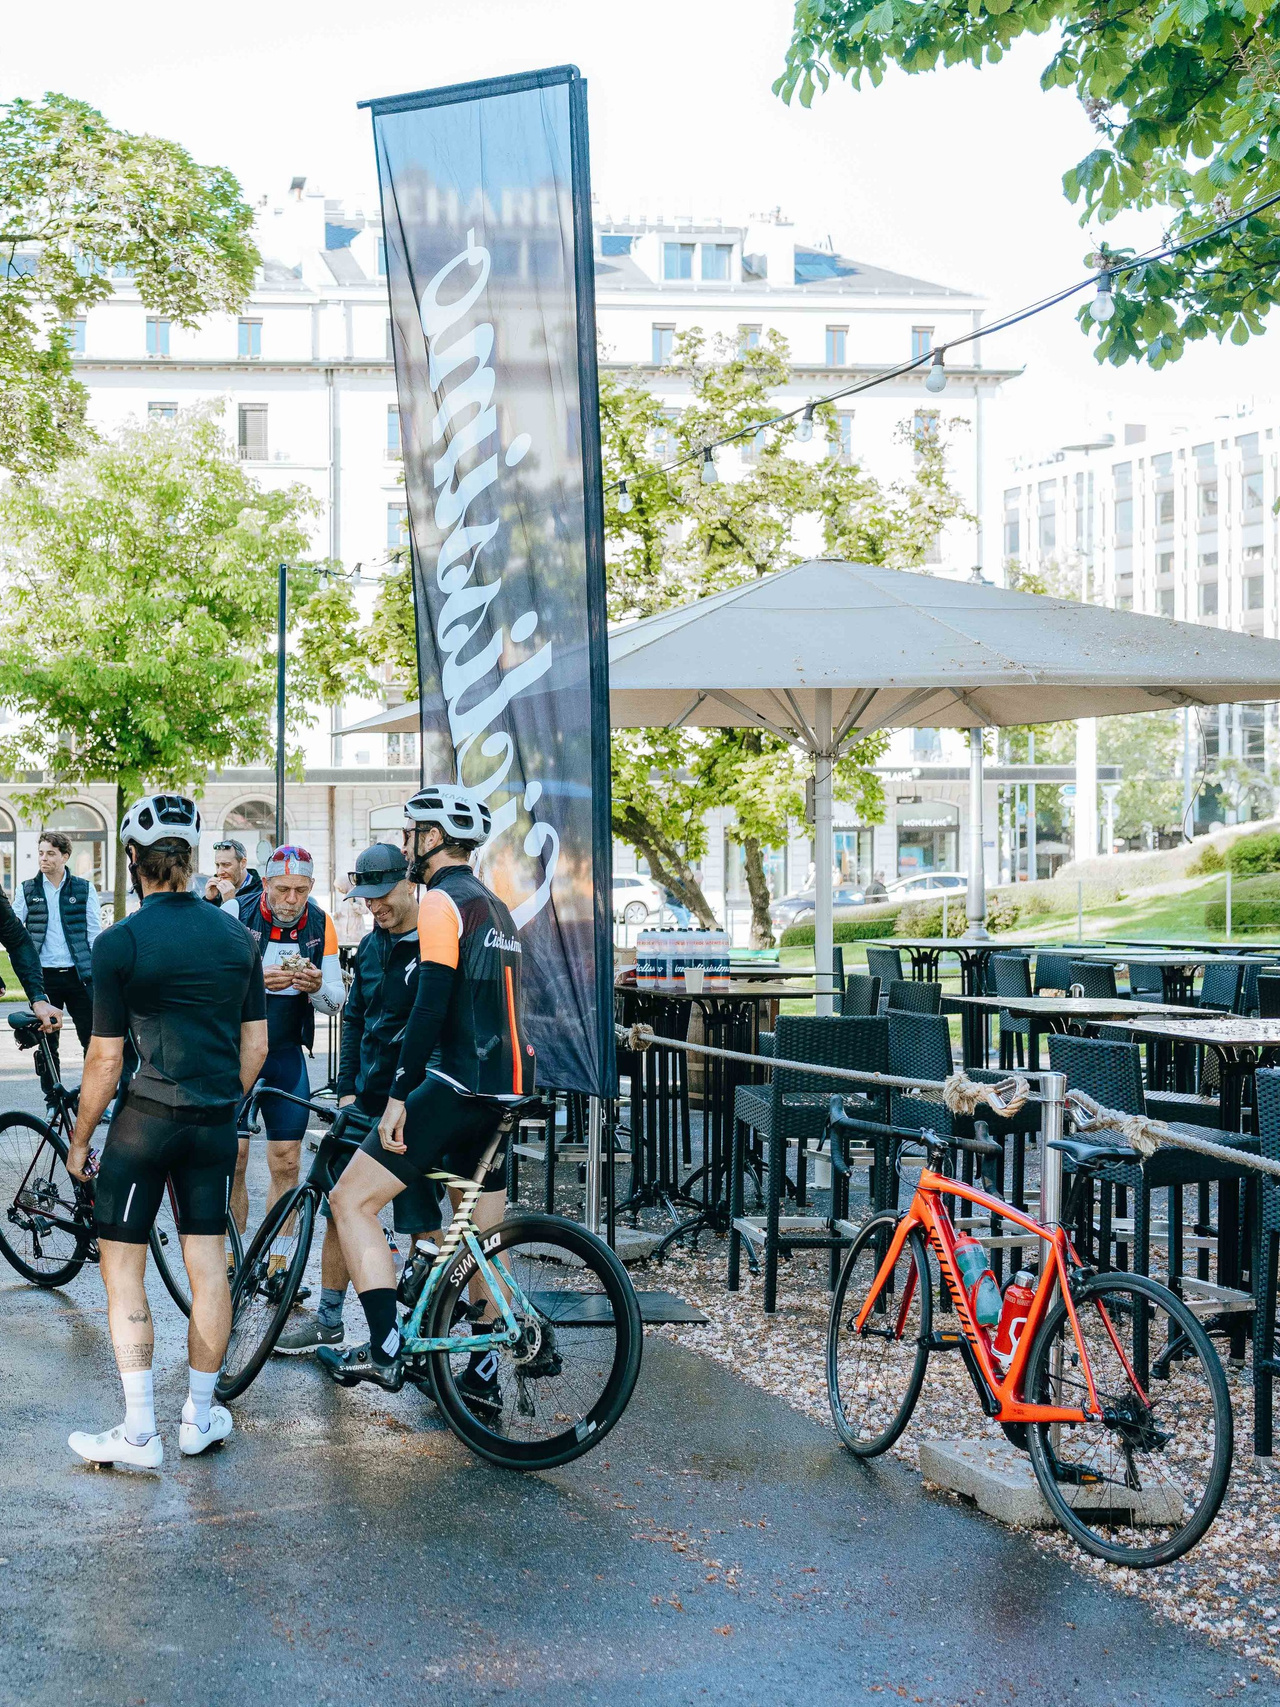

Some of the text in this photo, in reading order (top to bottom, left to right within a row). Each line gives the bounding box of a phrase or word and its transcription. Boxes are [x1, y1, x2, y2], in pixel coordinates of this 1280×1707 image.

[441, 793, 469, 803] KASK
[903, 819, 947, 827] MONTBLANC
[449, 1232, 502, 1288] DT WISS
[930, 1225, 979, 1345] SPECIALIZED
[338, 1363, 373, 1372] S-WORKS
